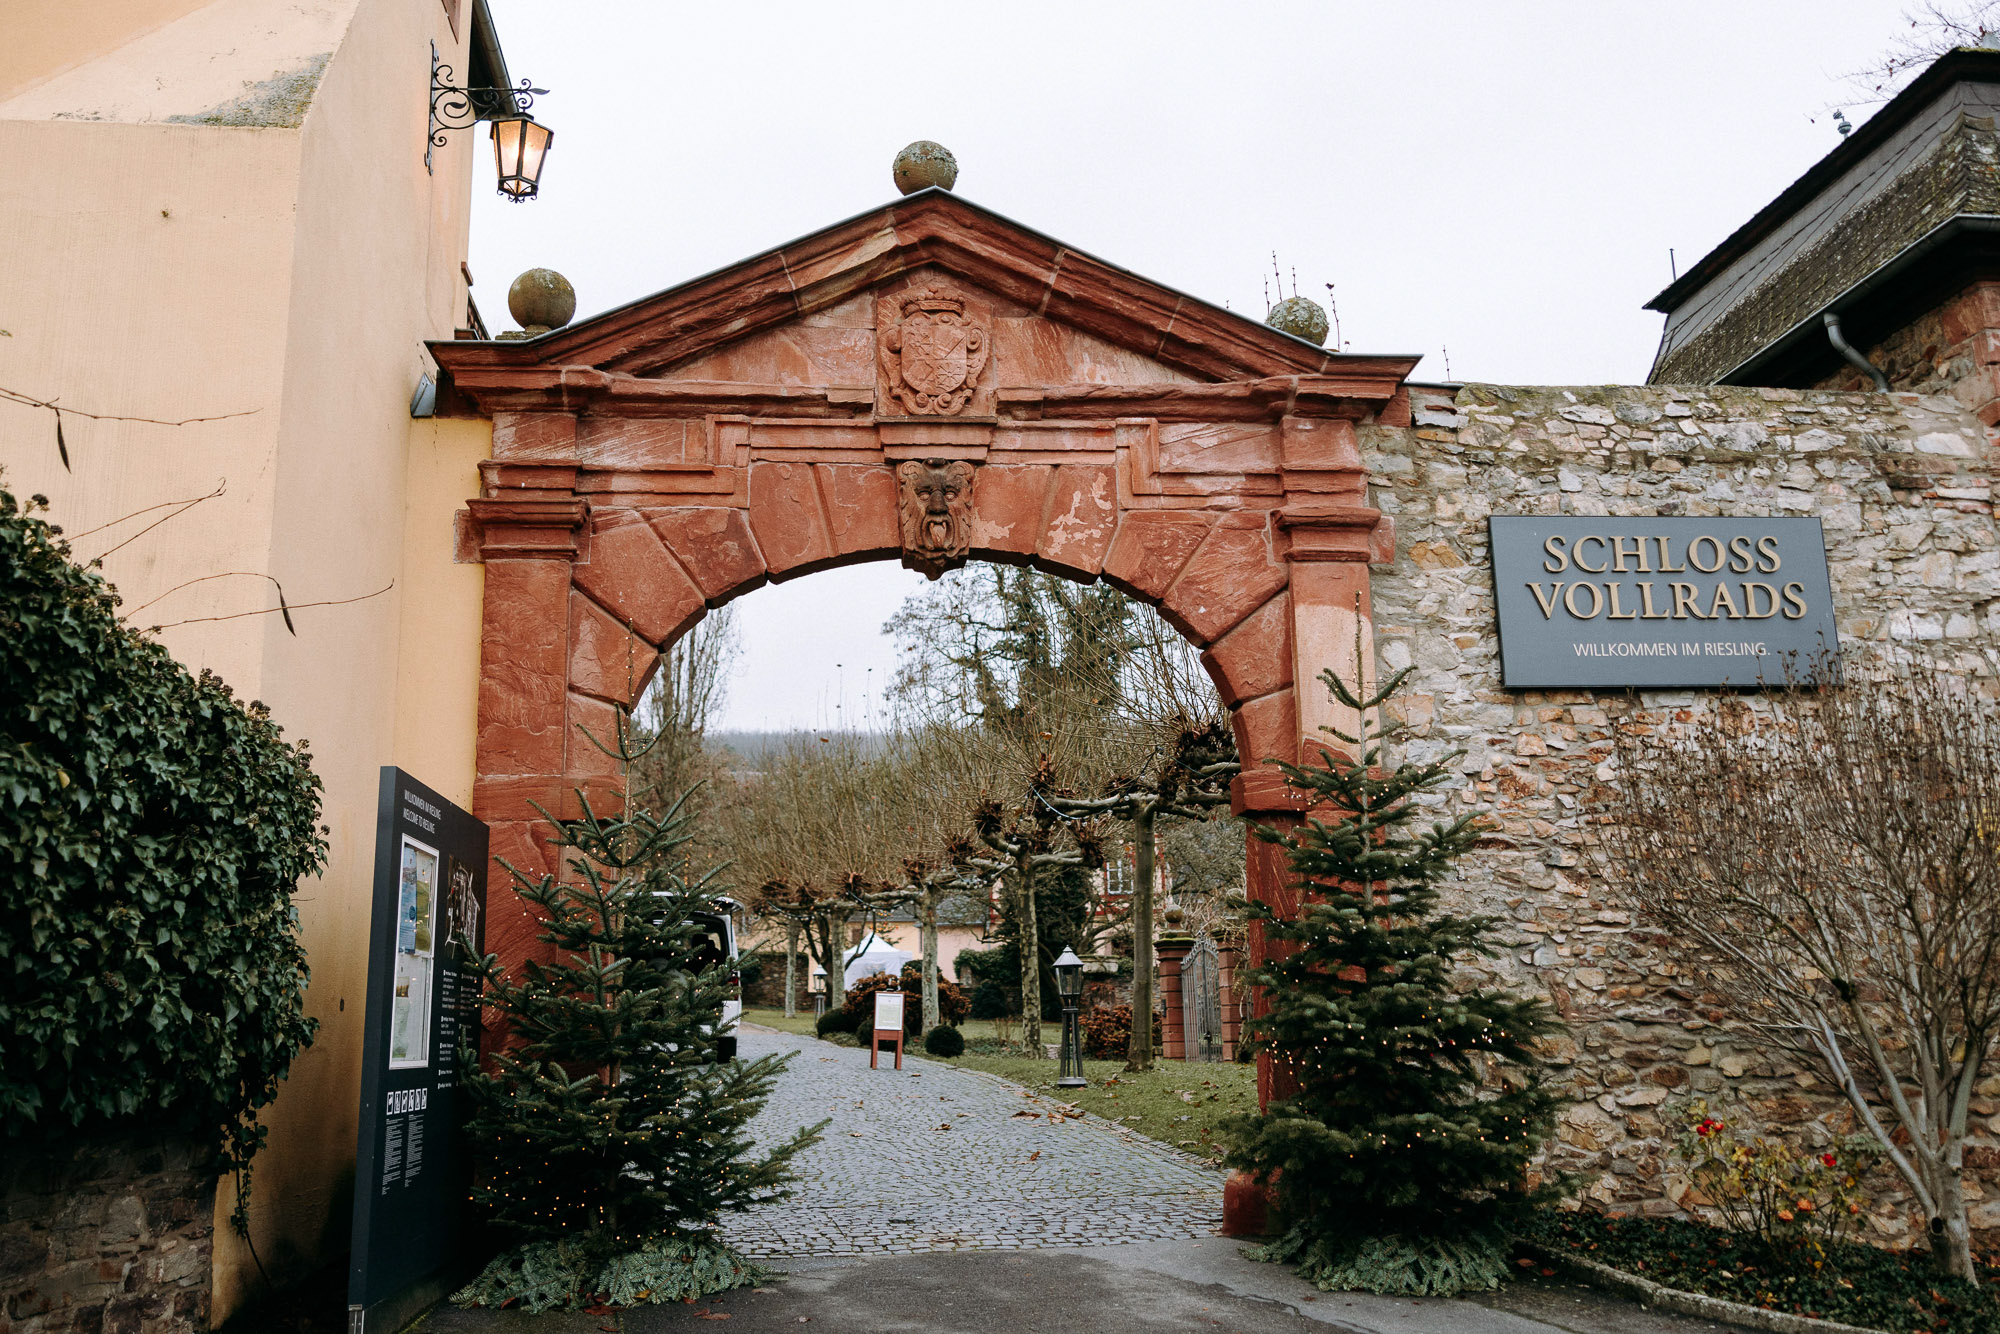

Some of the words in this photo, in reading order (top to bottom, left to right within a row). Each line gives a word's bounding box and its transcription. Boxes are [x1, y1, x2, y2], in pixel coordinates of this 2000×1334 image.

[1543, 535, 1782, 574] SCHLOSS
[1526, 581, 1808, 620] VOLLRADS
[1573, 643, 1677, 657] WILLKOMMEN
[1682, 643, 1700, 656] IM
[1705, 642, 1771, 656] RIESLING.
